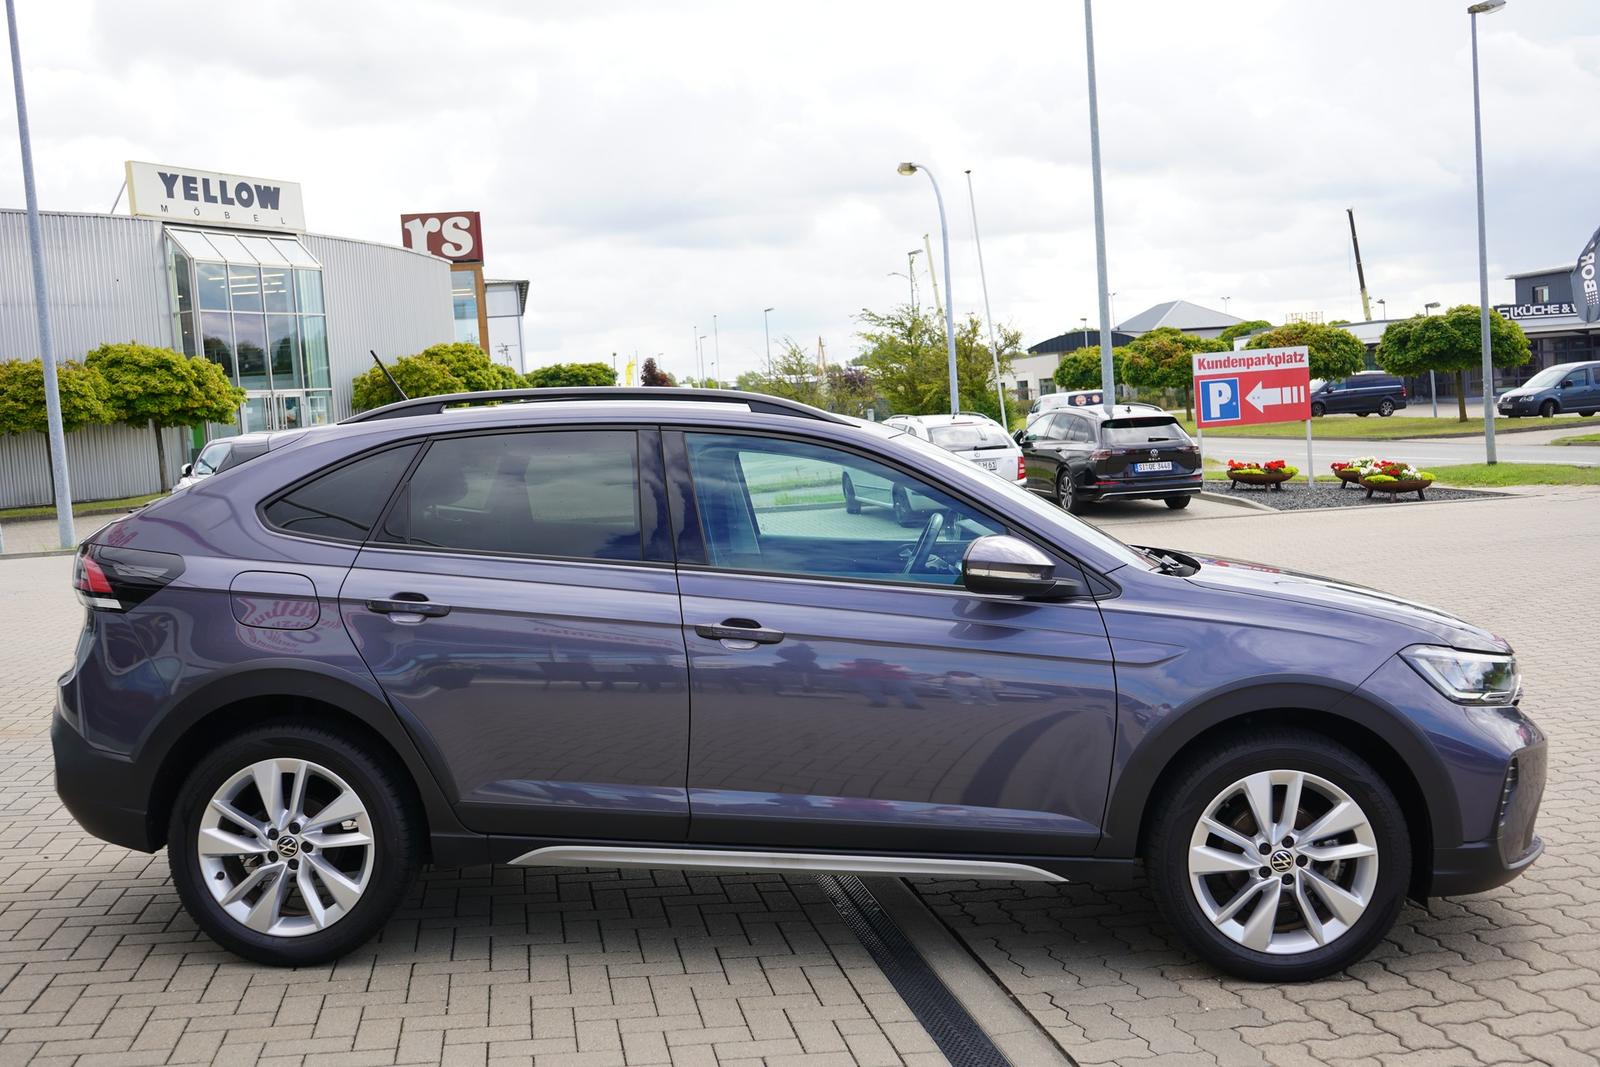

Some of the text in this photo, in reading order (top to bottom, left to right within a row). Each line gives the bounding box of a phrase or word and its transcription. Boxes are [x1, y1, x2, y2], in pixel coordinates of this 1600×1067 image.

[157, 171, 281, 211] YELLOW
[160, 204, 286, 225] MÖBEL
[404, 216, 474, 257] rs
[1514, 303, 1560, 316] KÜCHE
[1561, 303, 1571, 313] &
[1198, 352, 1305, 370] Kundenparkplatz
[1208, 382, 1232, 419] P
